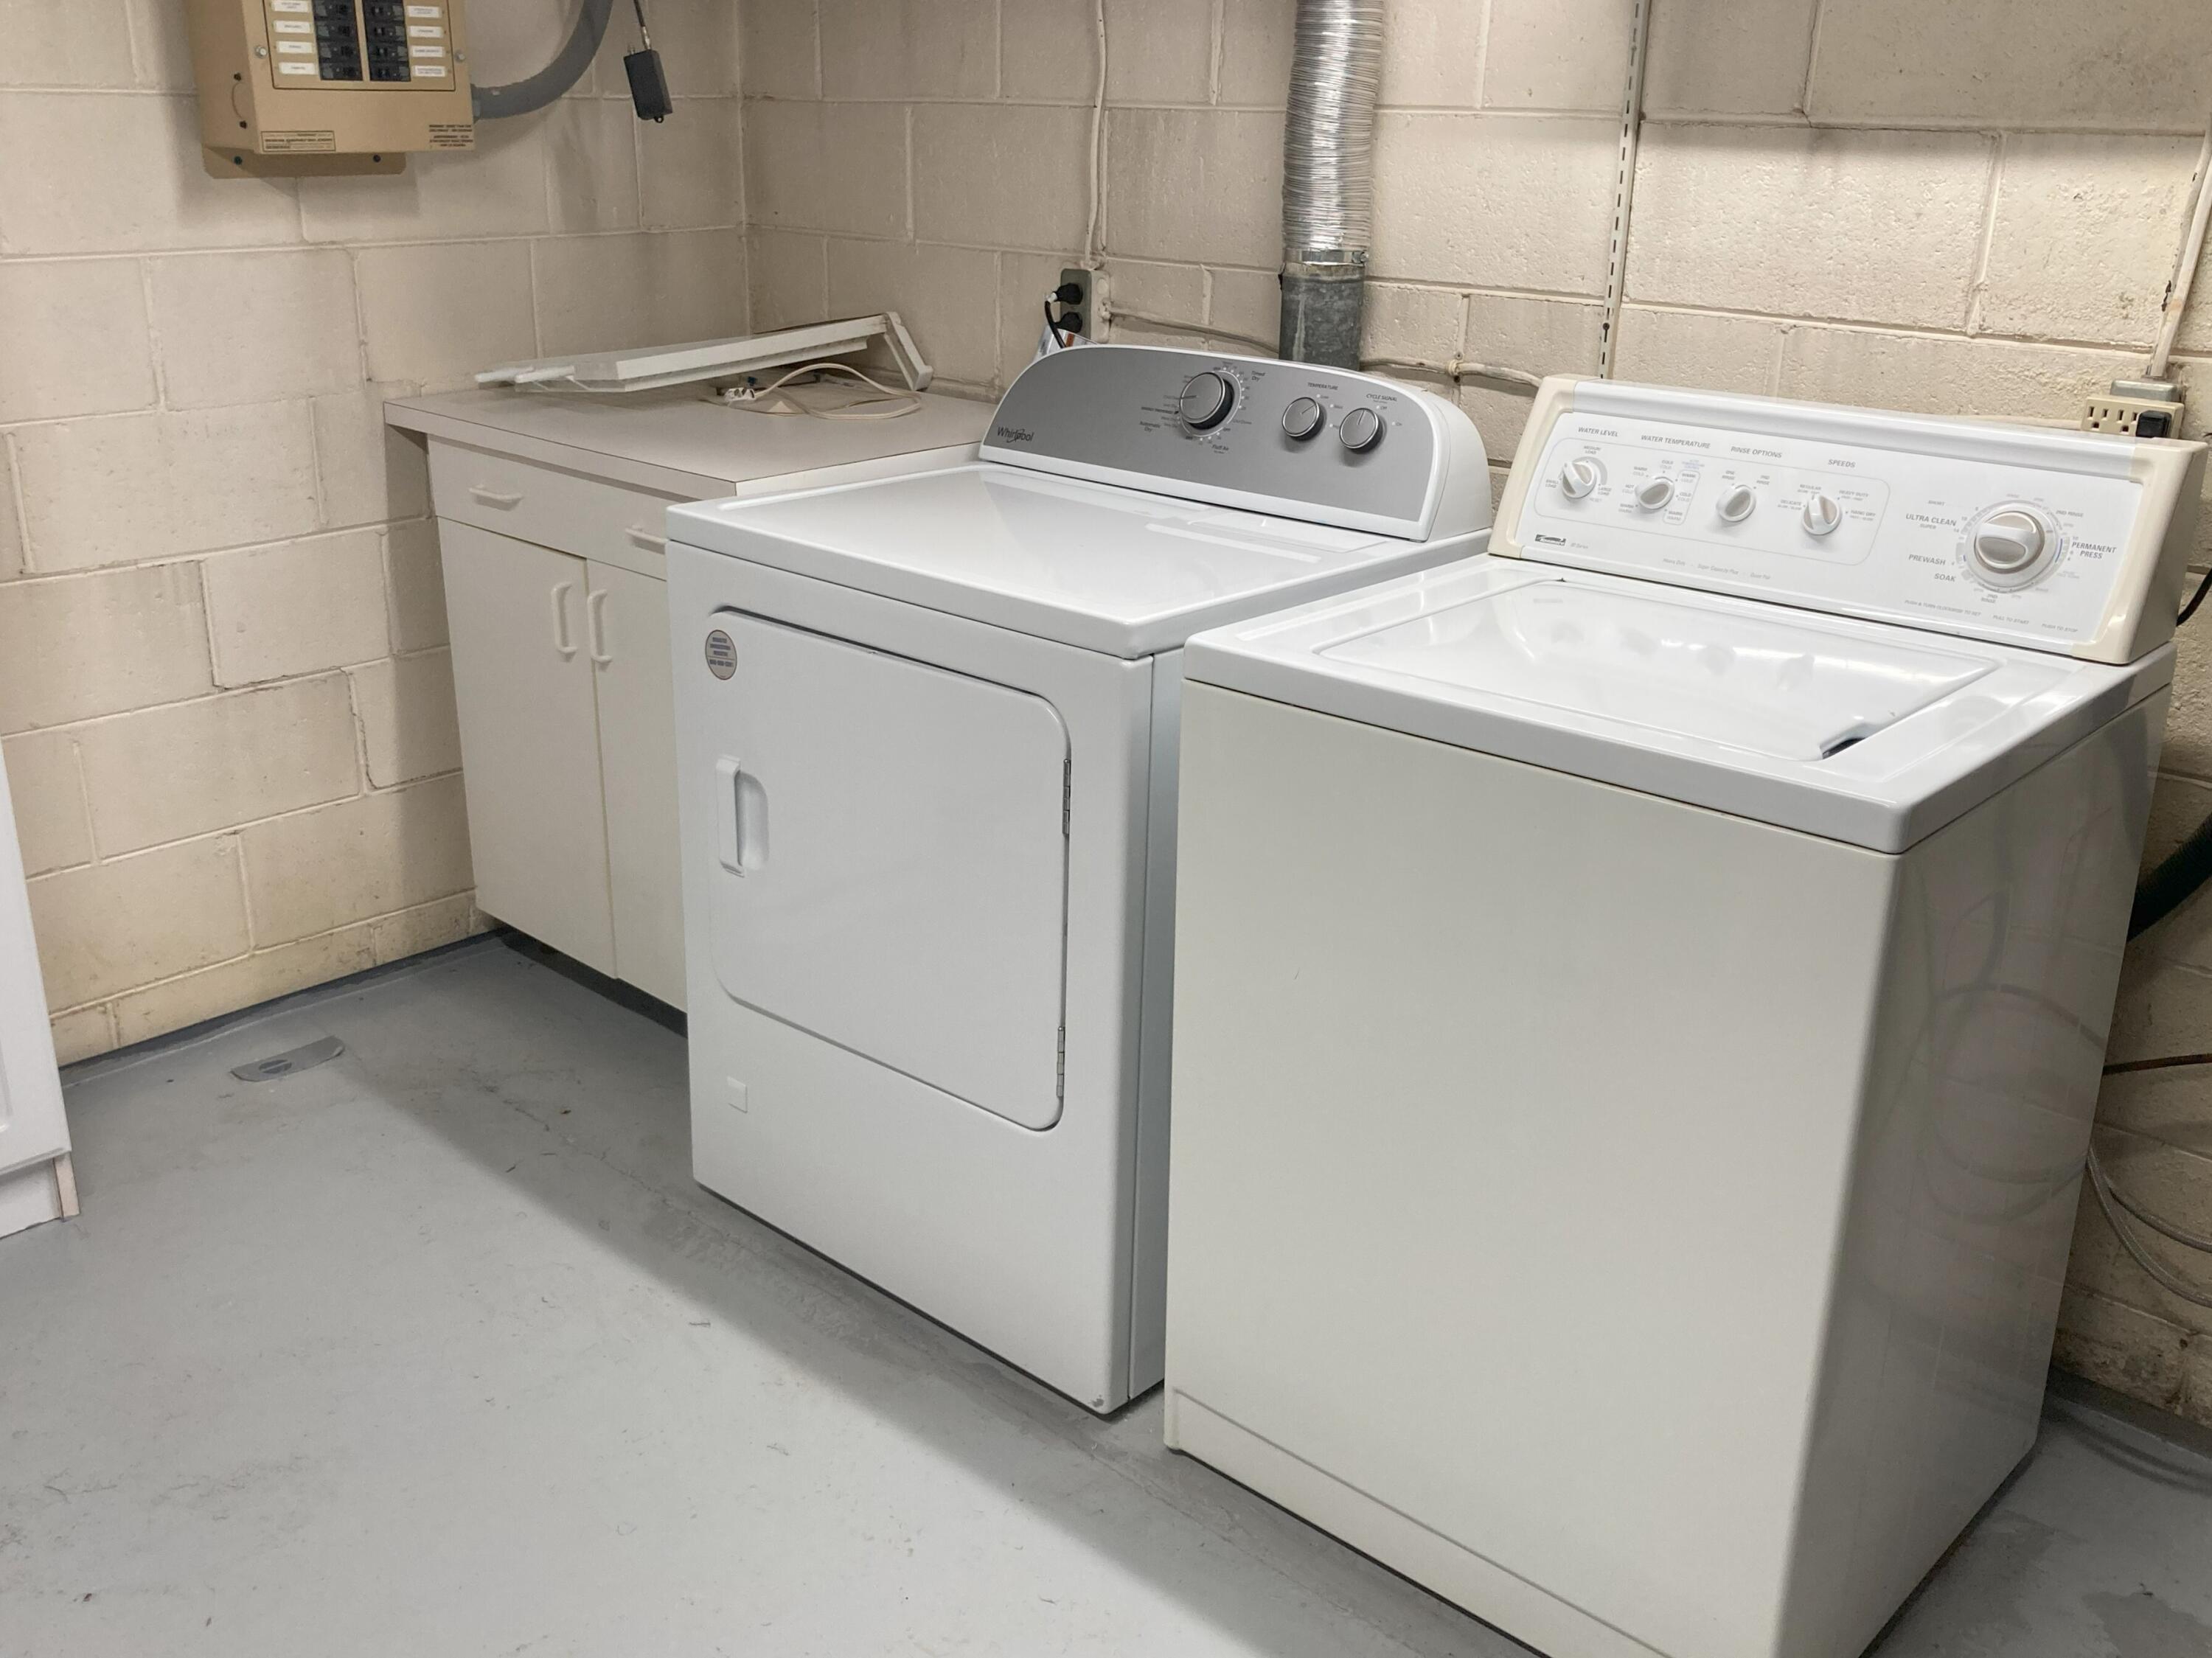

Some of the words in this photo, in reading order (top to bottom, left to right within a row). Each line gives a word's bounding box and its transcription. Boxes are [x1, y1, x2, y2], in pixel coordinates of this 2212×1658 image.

[1307, 382, 1338, 391] TEMPERATURE
[997, 426, 1034, 443] Whirlpool
[1578, 427, 1599, 436] WATER
[1600, 429, 1618, 437] LEVEL
[1641, 435, 1663, 443] WATER
[1665, 437, 1711, 449] TEMPERATURE
[1731, 446, 1751, 454] RINSE
[1752, 448, 1783, 459] OPTIONS
[1829, 459, 1856, 468] SPEEDS
[1905, 513, 1929, 523] ULTRA
[1931, 517, 1957, 526] CLEAN
[2072, 542, 2117, 554] PERMANENT
[1908, 554, 1946, 565] PREWASH
[2079, 550, 2103, 560] PRESS
[1934, 572, 1956, 582] SOAK
